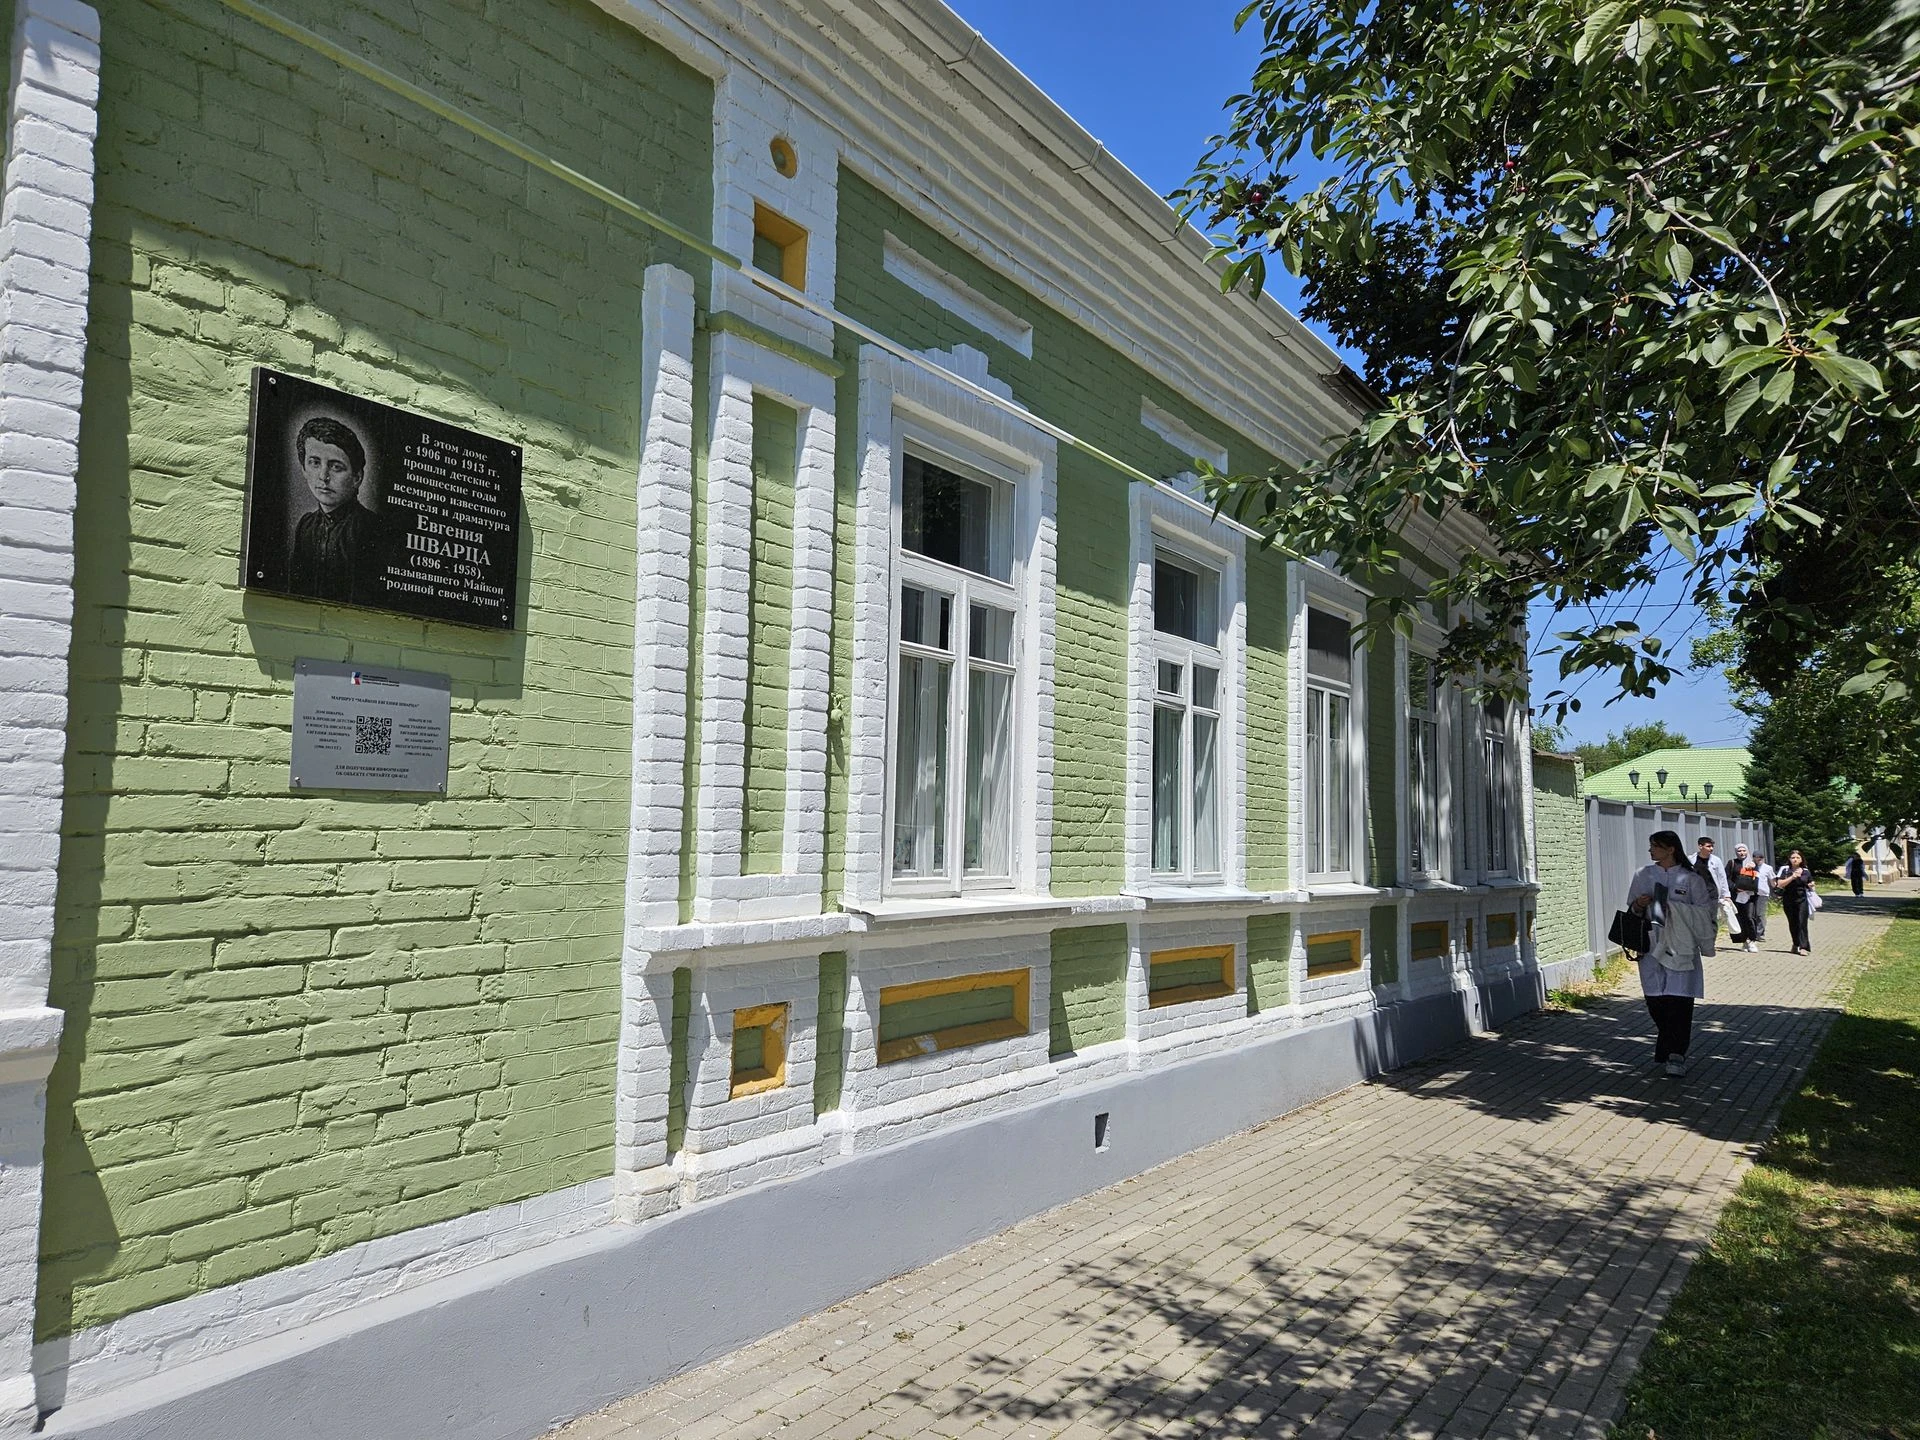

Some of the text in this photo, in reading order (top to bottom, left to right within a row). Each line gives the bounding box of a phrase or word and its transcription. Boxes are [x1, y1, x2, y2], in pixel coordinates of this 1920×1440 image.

[405, 445, 500, 478] с 1906 по 1913 гг.
[422, 433, 488, 462] В этом доме
[403, 458, 500, 491] прошли детские и
[406, 472, 497, 503] юношеские годы
[387, 495, 510, 532] писателя и драматурга
[393, 482, 507, 518] всемирно известного
[416, 514, 484, 544] Евгения
[406, 532, 491, 566] ШВАРЦА
[387, 566, 504, 595] называвшего Майкоп
[410, 554, 441, 570] (1896
[453, 563, 485, 580] 1958),
[438, 589, 469, 602] своей
